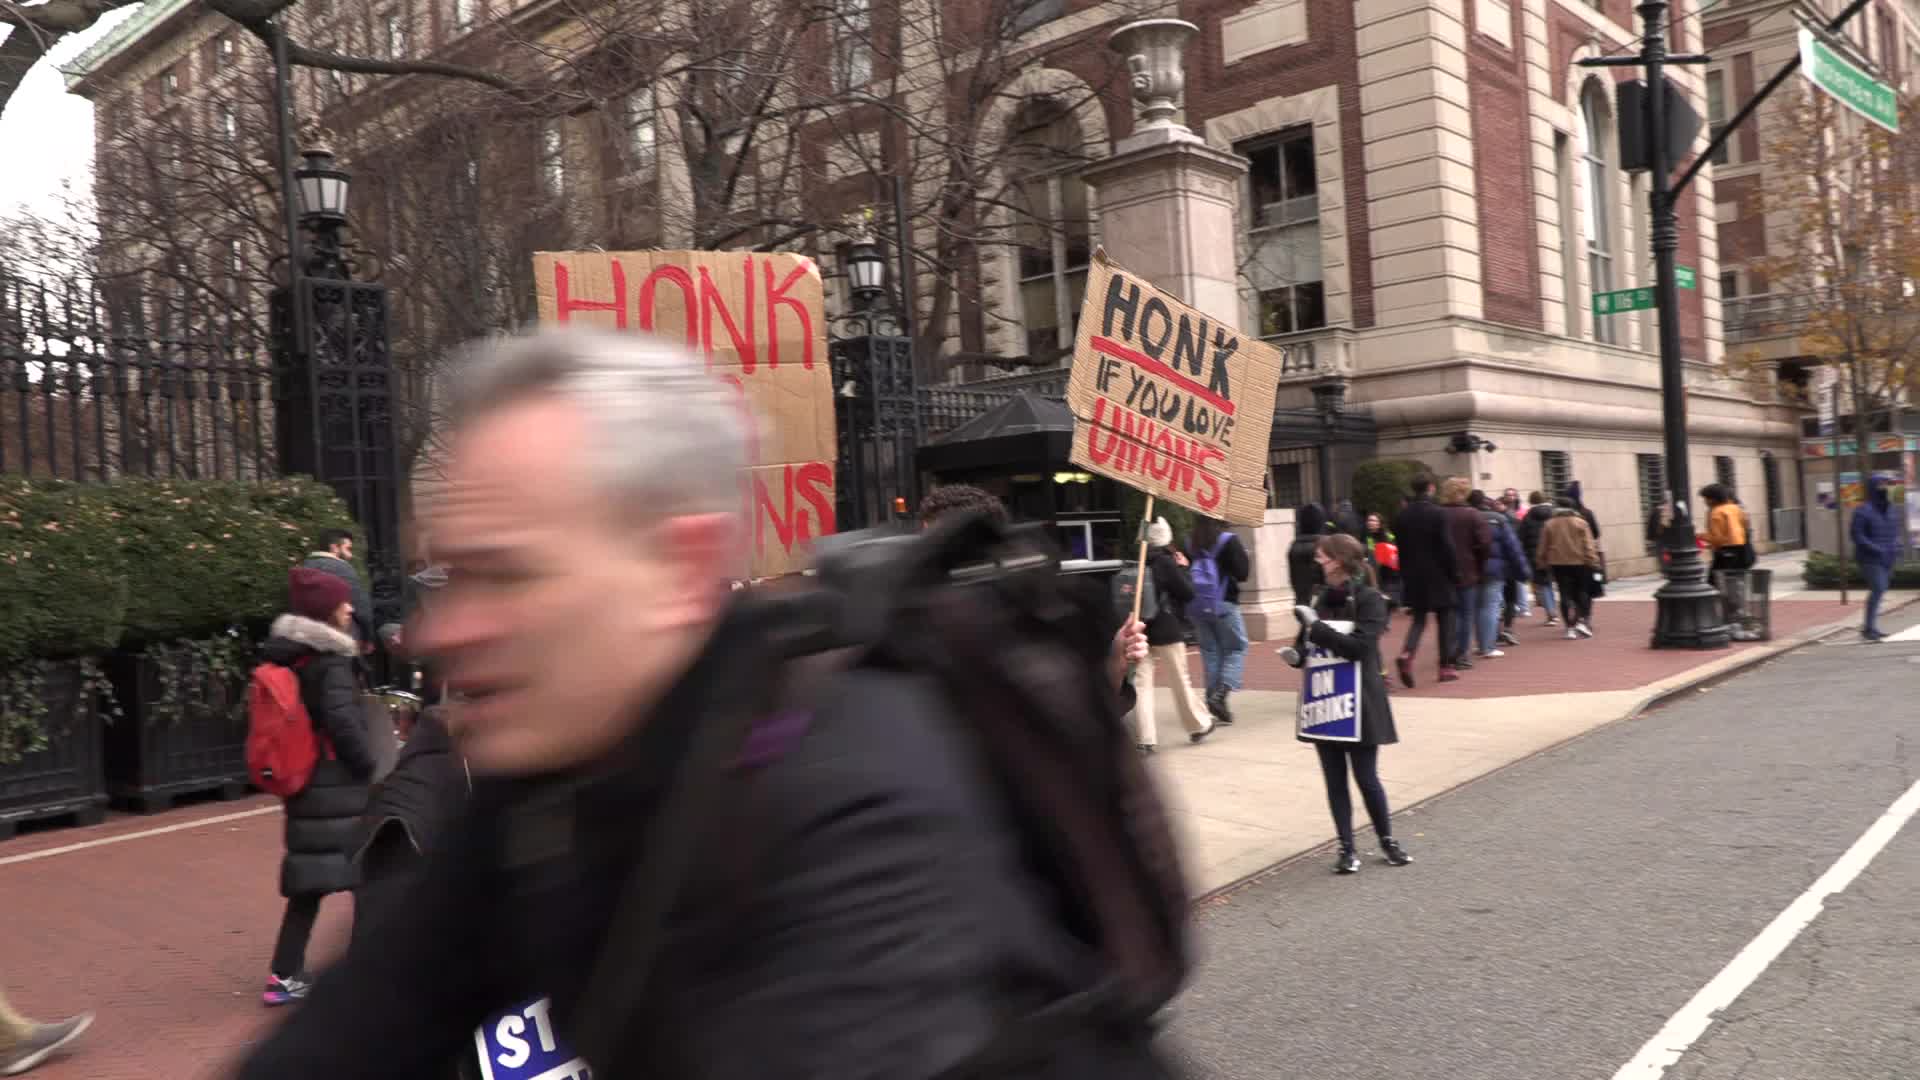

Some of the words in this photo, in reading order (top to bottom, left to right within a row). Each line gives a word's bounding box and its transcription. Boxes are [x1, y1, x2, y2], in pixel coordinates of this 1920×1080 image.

[555, 256, 813, 375] HONK
[1102, 274, 1239, 401] HONK
[1096, 355, 1121, 393] IF
[1126, 367, 1181, 424] YOU
[1183, 396, 1236, 448] LOVE
[1301, 693, 1355, 729] STRIKE
[1311, 669, 1335, 698] ON
